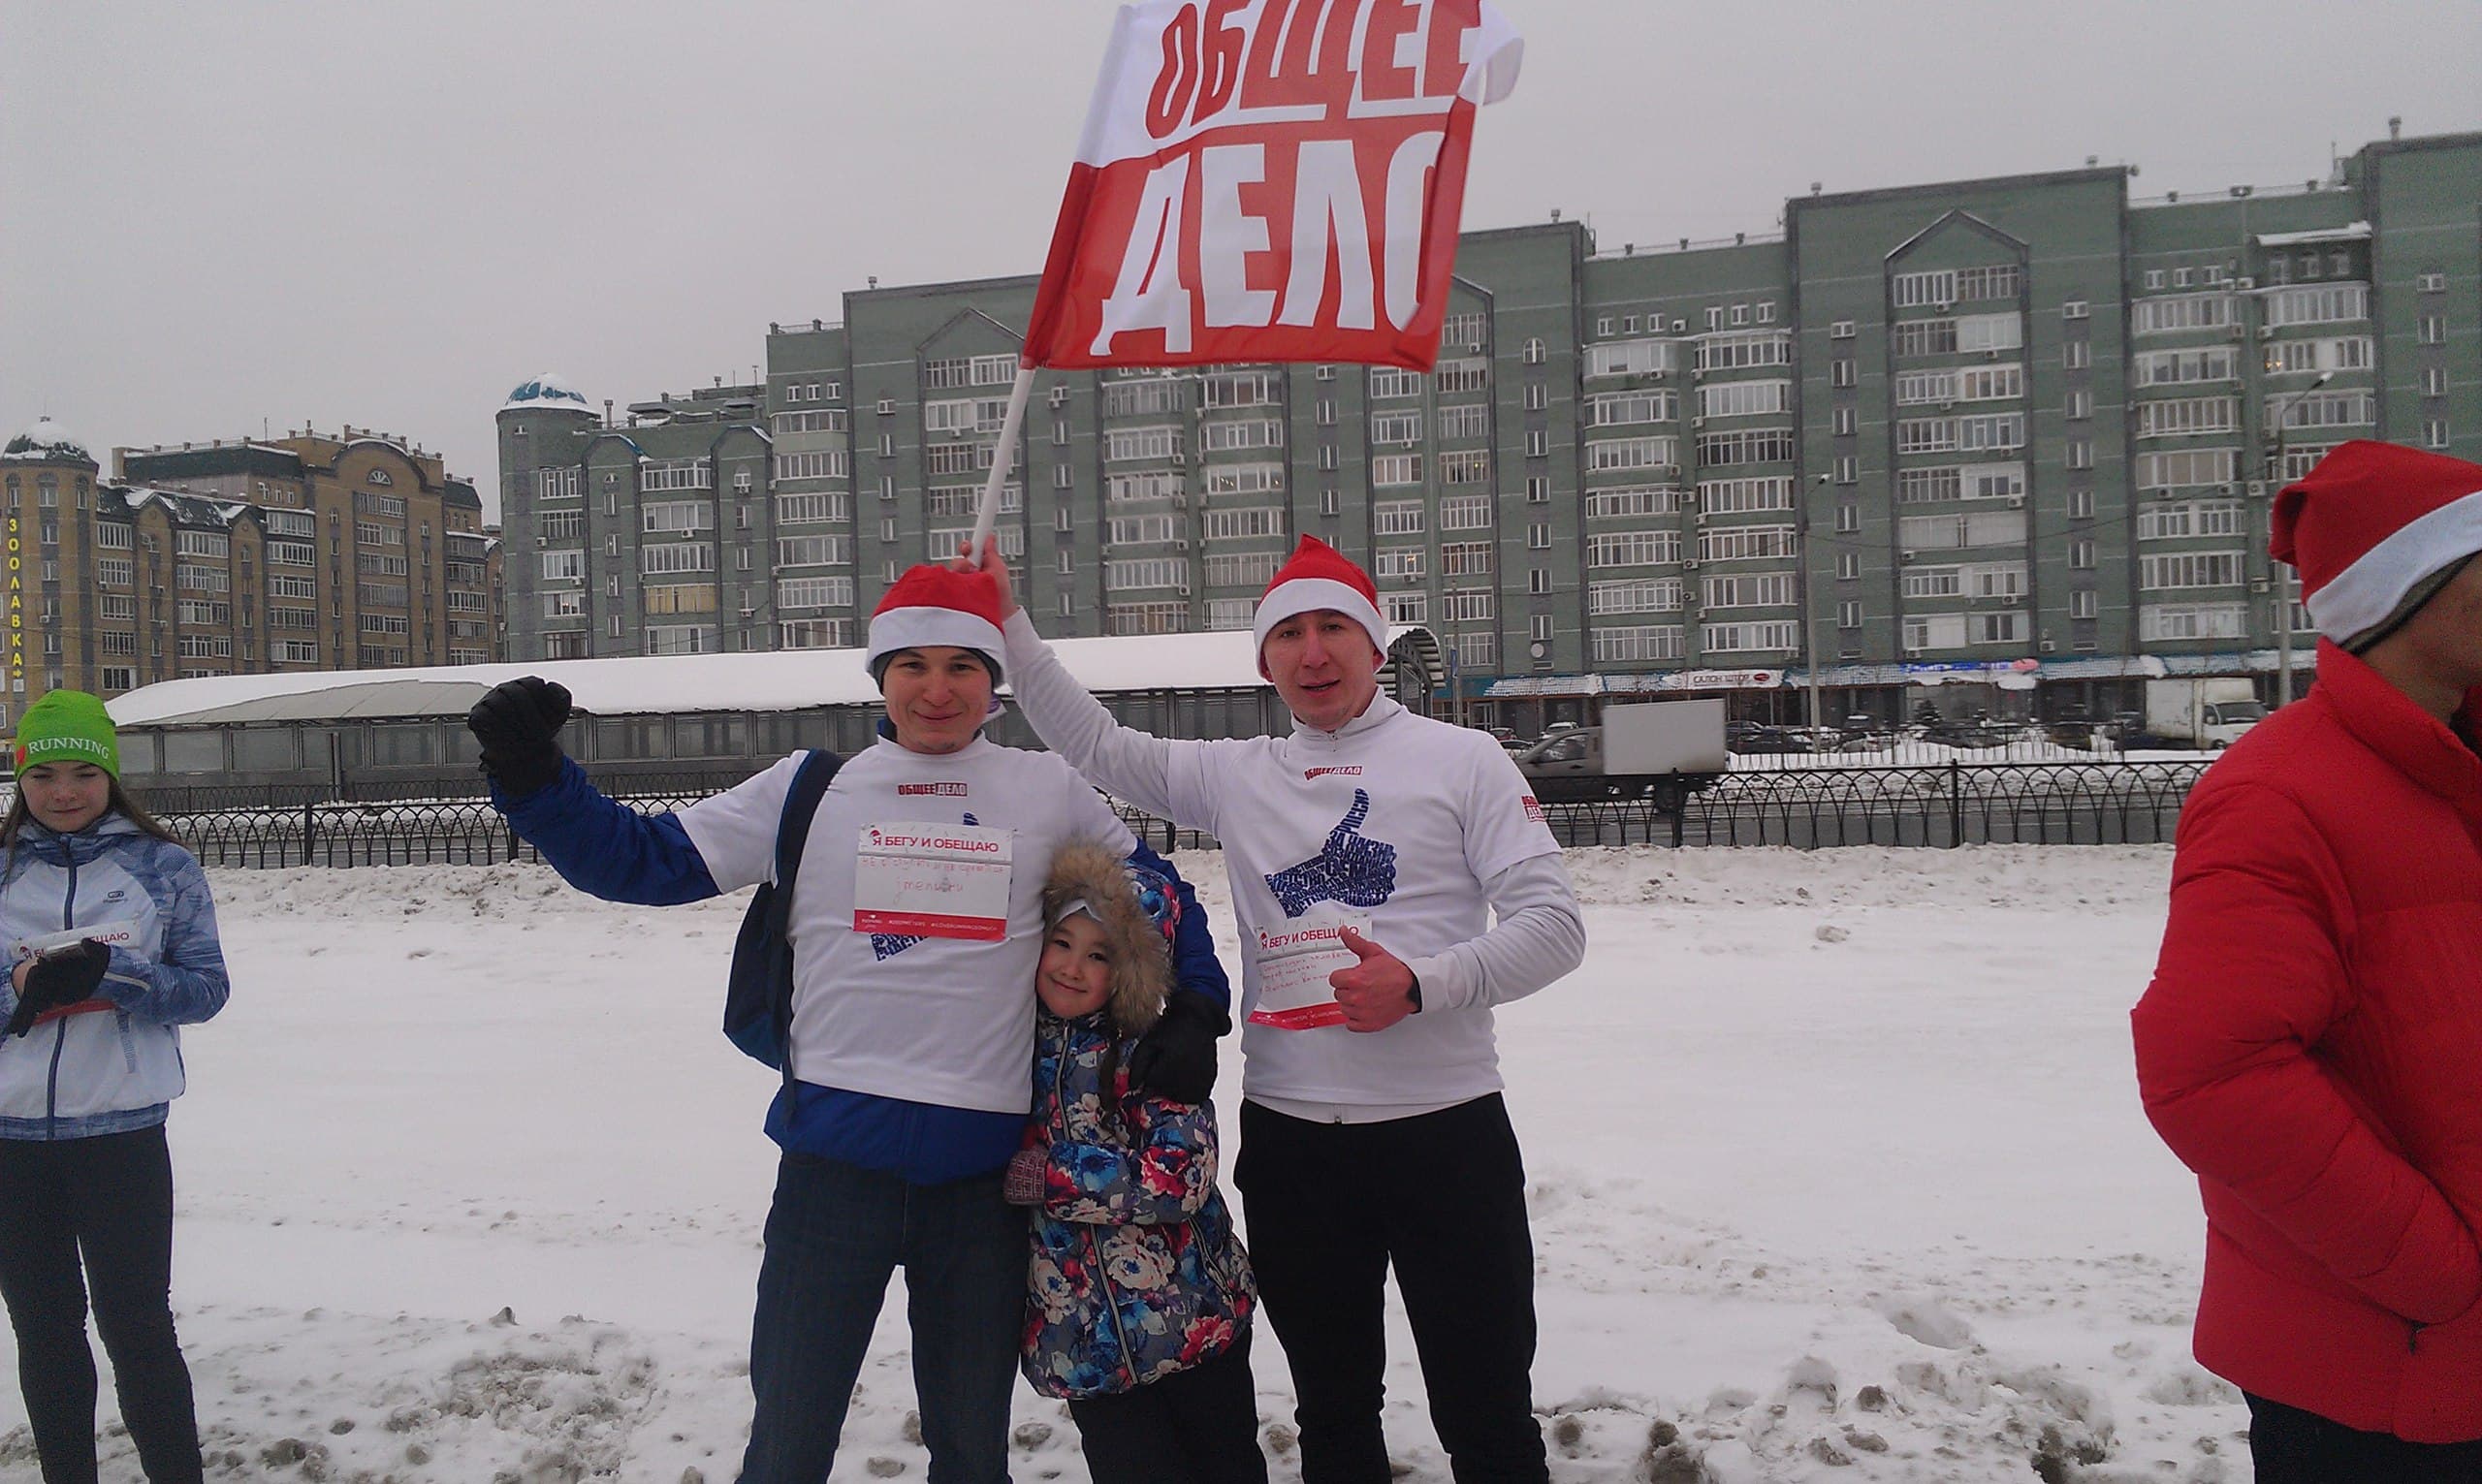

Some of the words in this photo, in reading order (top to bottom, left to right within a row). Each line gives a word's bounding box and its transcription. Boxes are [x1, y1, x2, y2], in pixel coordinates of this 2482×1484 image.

[9, 518, 23, 667] ЗООЛАВКА
[28, 737, 110, 759] RUNNING
[885, 836, 918, 847] БЕГУ
[921, 837, 931, 847] И
[934, 838, 999, 853] ОБЕЩАЮ
[1269, 934, 1290, 948] БЕГУ
[1292, 933, 1299, 943] И
[1301, 926, 1359, 941] ОБЕЩЮ
